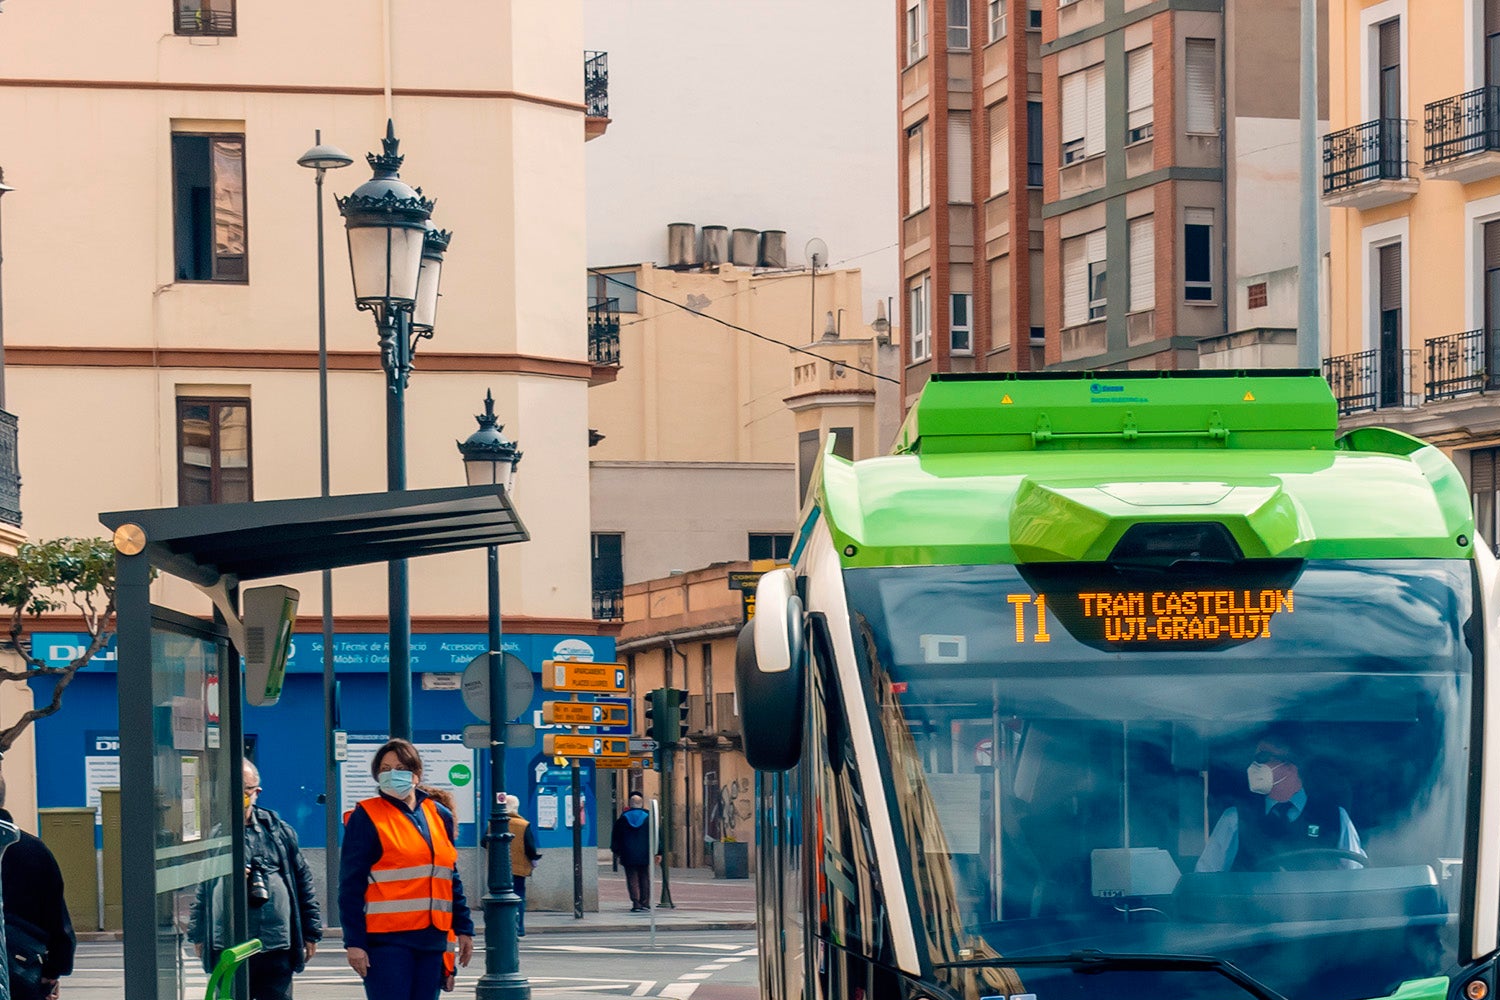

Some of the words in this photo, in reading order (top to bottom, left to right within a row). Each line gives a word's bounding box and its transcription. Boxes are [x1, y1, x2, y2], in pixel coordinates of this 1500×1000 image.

[1078, 591, 1145, 616] TRAM
[1151, 589, 1294, 615] CASTELLON
[1007, 593, 1051, 643] T1
[1104, 614, 1271, 641] UJI-GRAO-UJI
